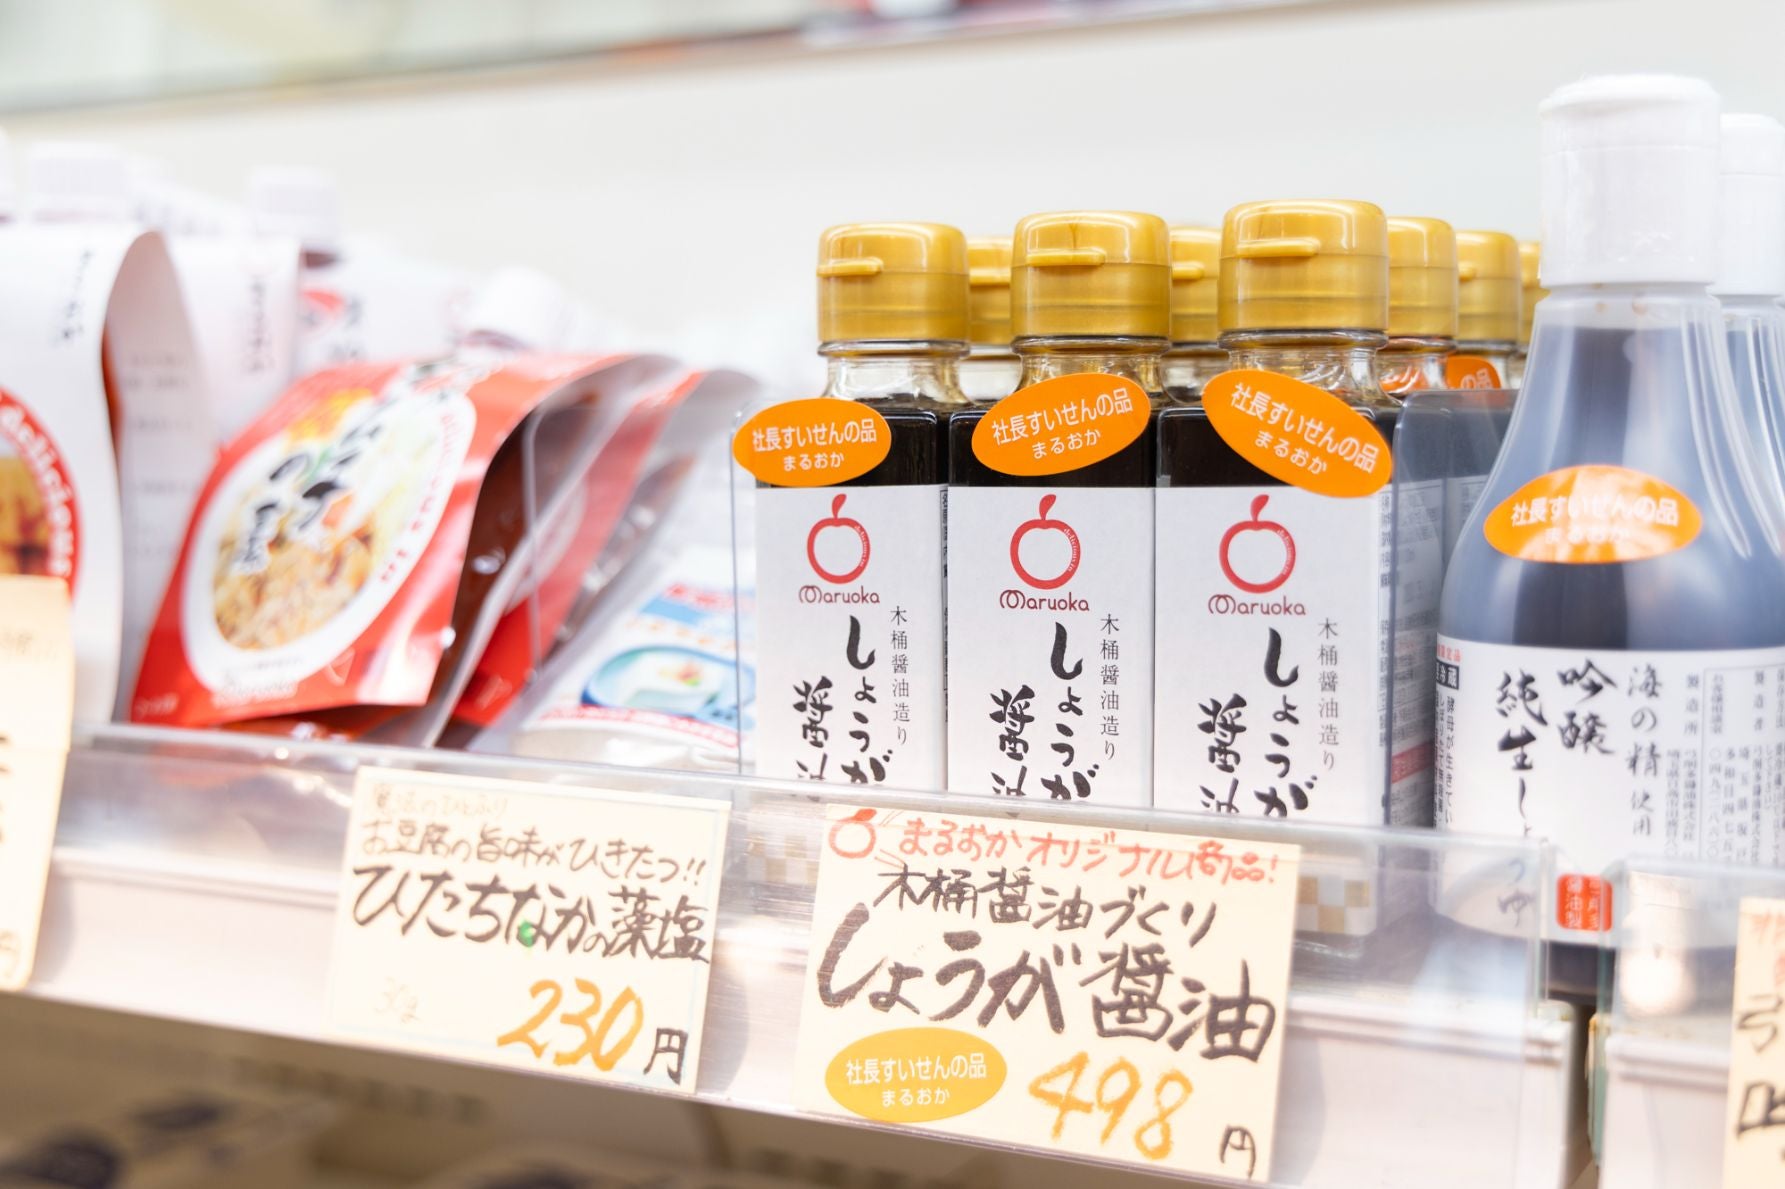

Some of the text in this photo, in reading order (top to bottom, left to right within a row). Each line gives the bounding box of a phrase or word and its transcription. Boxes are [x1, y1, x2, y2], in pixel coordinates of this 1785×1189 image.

[752, 418, 877, 453] 社長すいせんの品
[991, 388, 1133, 446] 社長すいせんの品
[1031, 428, 1101, 460] まるおか
[1230, 382, 1380, 474] 社長すいせんの品
[783, 451, 845, 472] まるおか
[1254, 430, 1328, 475] まるおか
[1510, 496, 1680, 527] 社長すいせんの品
[799, 586, 880, 605] Maruoka
[999, 589, 1090, 612] Maruoka
[1207, 594, 1306, 616] Maruoka
[841, 614, 893, 785] しょうが
[890, 605, 911, 746] 木桶醤油造り
[1100, 613, 1120, 760] 木桶醤油造り
[1317, 617, 1339, 771] 木桶醤油造り
[1040, 621, 1100, 801] しょうが
[1254, 627, 1318, 817] しょうが
[1626, 663, 1663, 836] 海の精使用
[873, 862, 1217, 947] 木桶醤油づくり
[817, 902, 1276, 1064] しょうが醤油
[846, 1052, 987, 1086] 社長すいせんの品
[881, 1087, 950, 1109] まるおか
